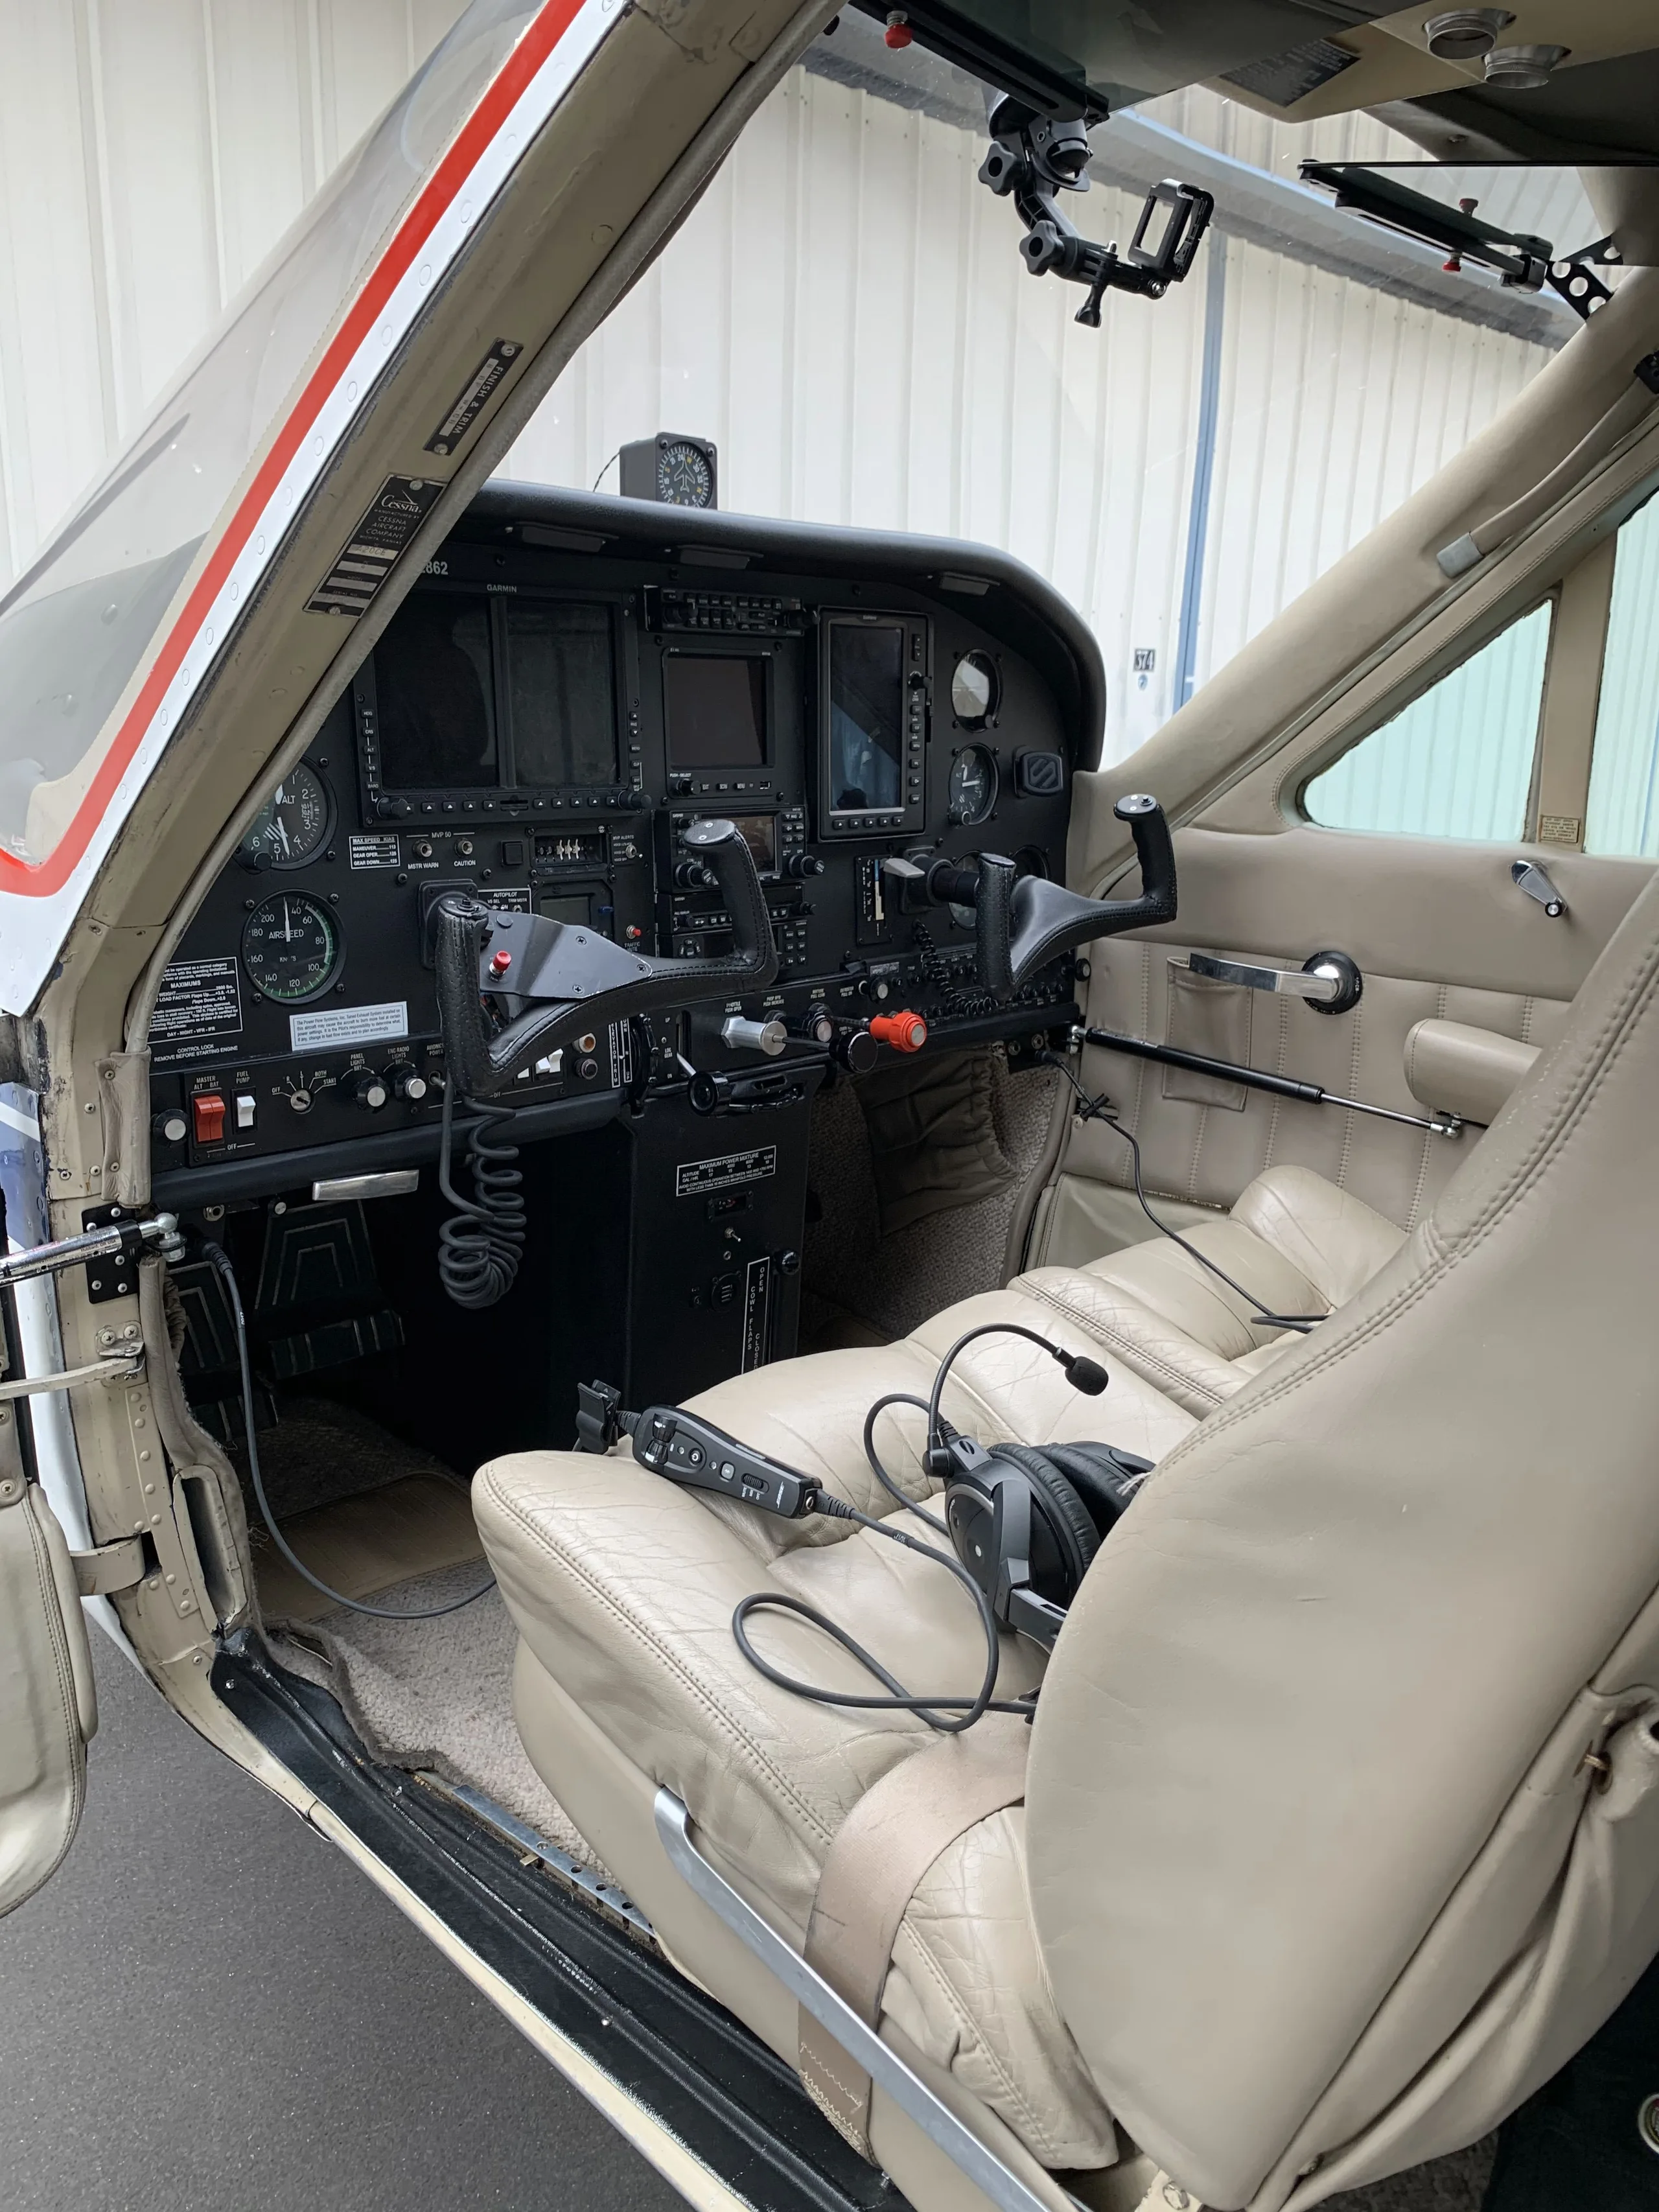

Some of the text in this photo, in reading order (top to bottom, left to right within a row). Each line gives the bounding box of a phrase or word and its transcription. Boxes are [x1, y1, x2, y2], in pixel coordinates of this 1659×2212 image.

[478, 366, 504, 397] FINISH
[453, 413, 472, 433] TRIM
[381, 495, 419, 513] Cessna
[378, 516, 406, 525] CESSNA
[371, 522, 406, 531] AIRCRAFT
[366, 529, 404, 539] COMPANY
[422, 561, 448, 575] 862
[487, 584, 517, 594] GARMIN
[302, 789, 308, 799] 2
[282, 795, 295, 804] ALT
[304, 819, 310, 830] 3
[253, 837, 260, 847] 6
[294, 835, 301, 844] 4
[274, 843, 281, 854] 5
[251, 928, 263, 937] 180
[269, 929, 304, 939] AIRSEED
[170, 980, 201, 988] MAXIMUMS
[627, 1071, 630, 1080] UP
[739, 1153, 759, 1161] MIXTURE
